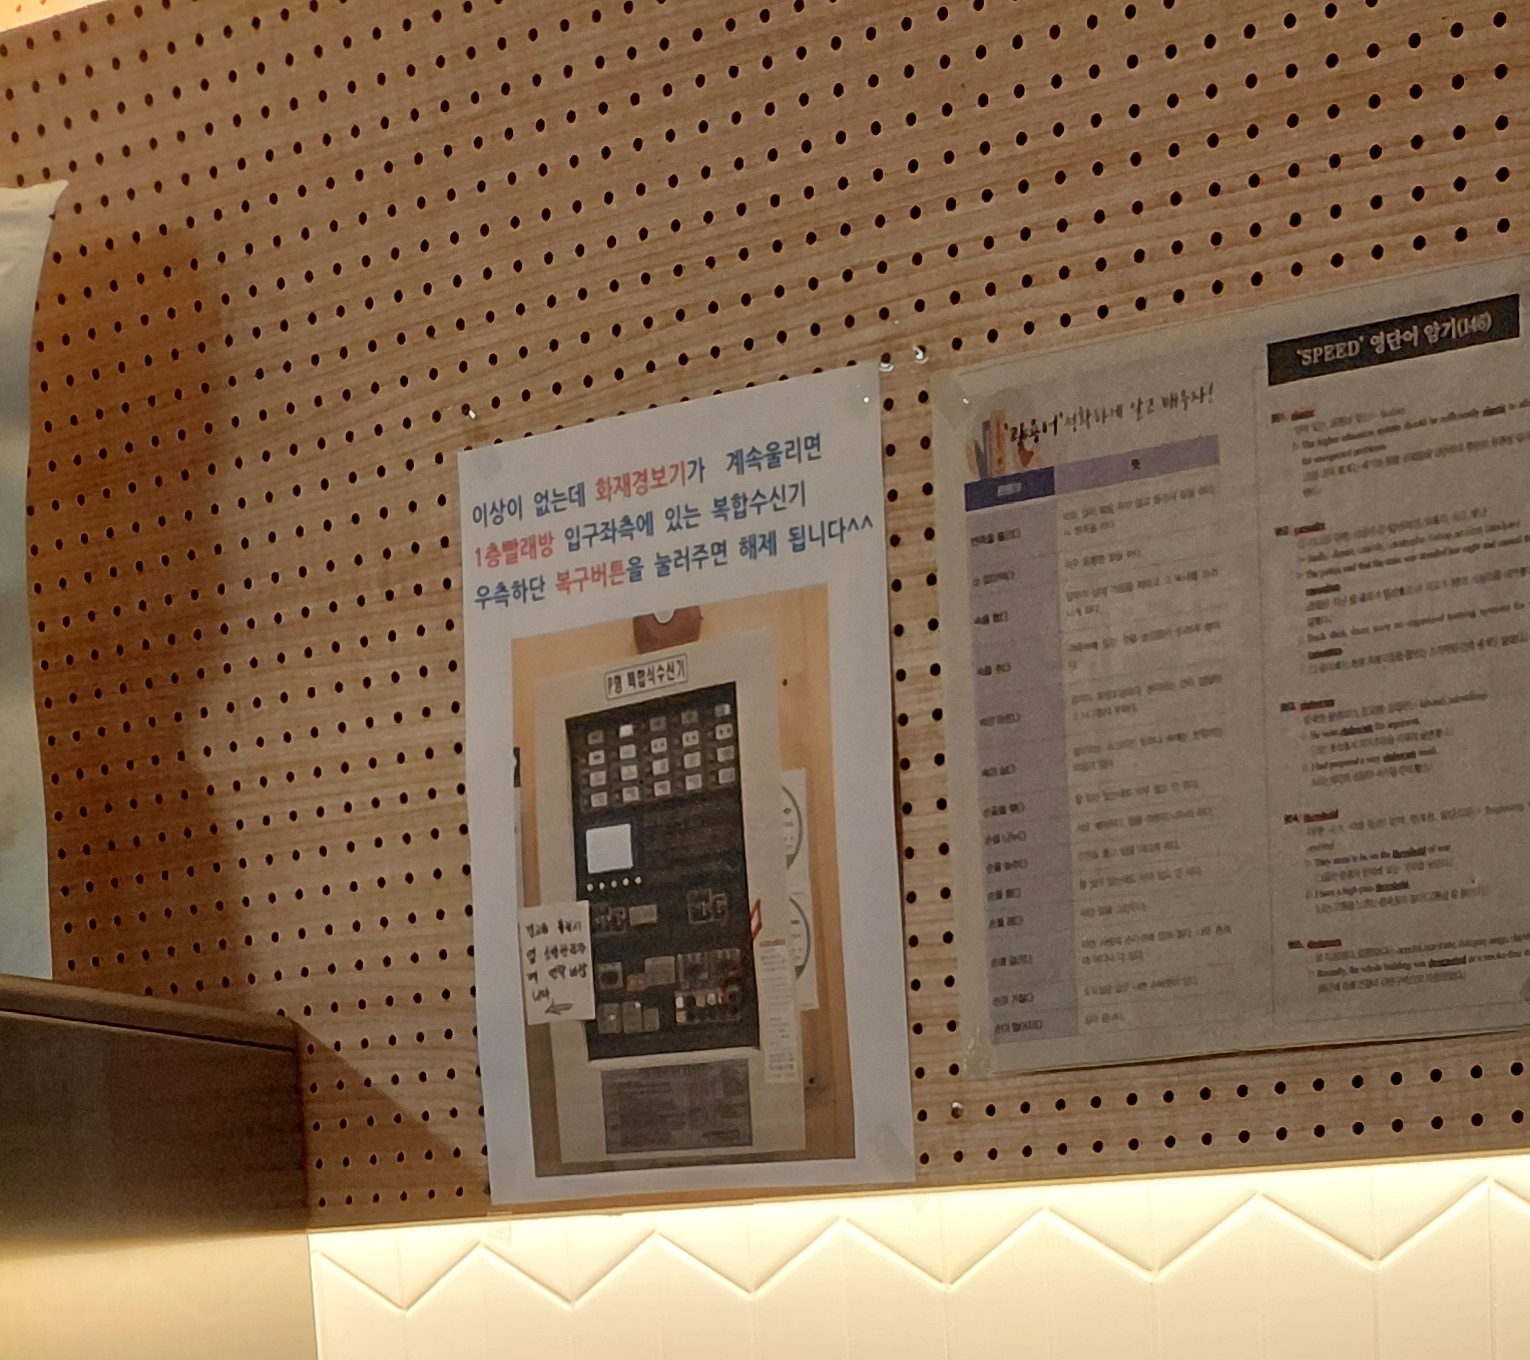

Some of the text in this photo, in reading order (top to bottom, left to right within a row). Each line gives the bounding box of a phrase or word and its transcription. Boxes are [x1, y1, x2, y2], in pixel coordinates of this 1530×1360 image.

[1370, 326, 1419, 354] 영단어
[472, 433, 821, 528] 이상이 없는데 화재경보기가 계속울리면
[475, 480, 807, 569] 1층빨래방 입구좌측에 있는 복합수신기
[475, 575, 546, 610] 우측하단
[556, 554, 644, 594] 복구버튼을
[655, 538, 729, 578] 눌러주면
[739, 528, 778, 560] 해제
